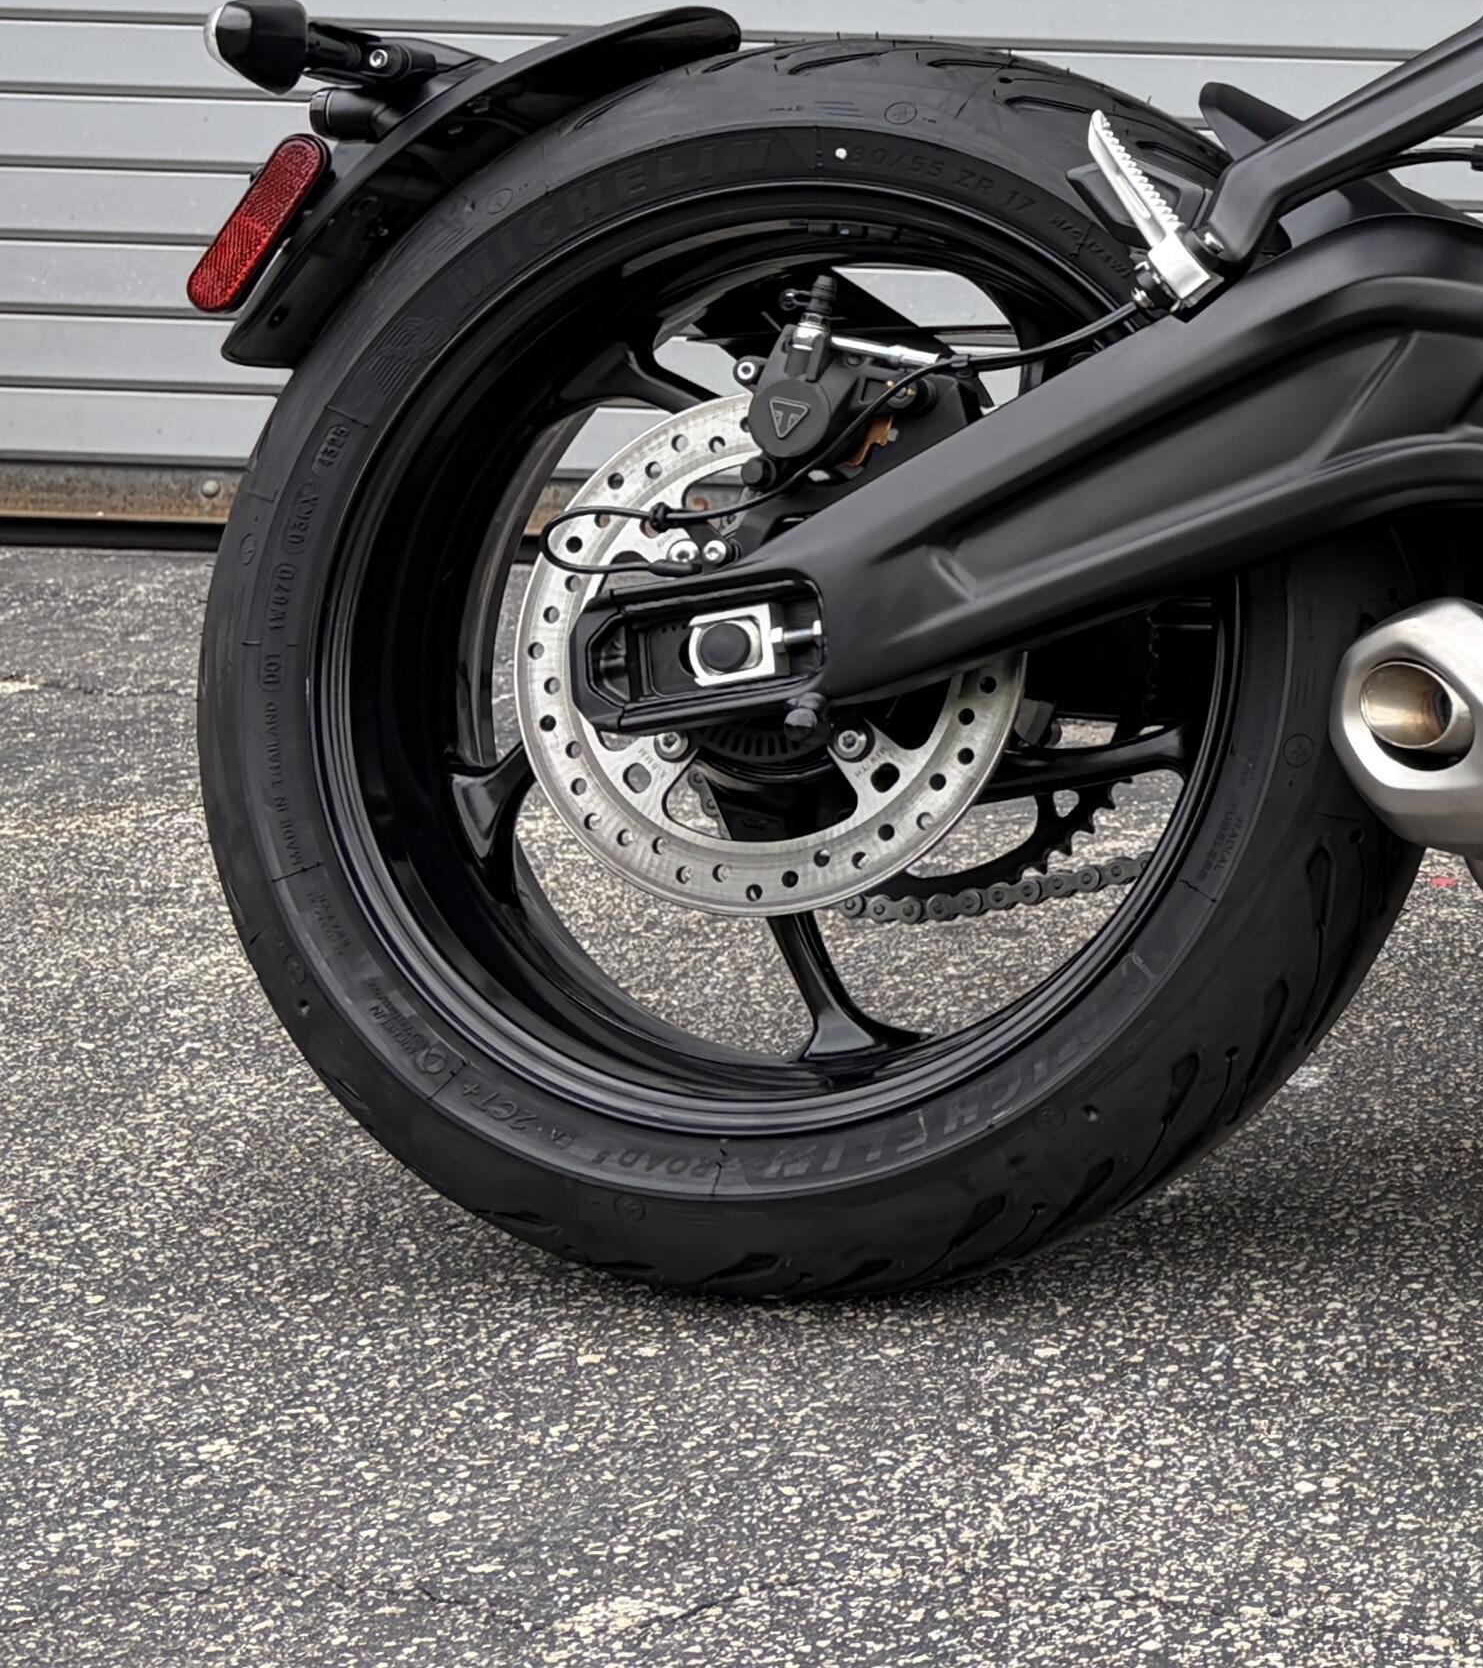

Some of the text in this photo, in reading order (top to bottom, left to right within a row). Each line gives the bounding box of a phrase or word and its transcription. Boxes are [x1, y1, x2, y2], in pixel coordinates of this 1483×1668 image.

[440, 138, 771, 309] MICHELIN
[833, 143, 1035, 217] 80/55 ZR 17
[262, 701, 306, 867] MADE IN THAILAND
[616, 1144, 713, 1179] ROAD
